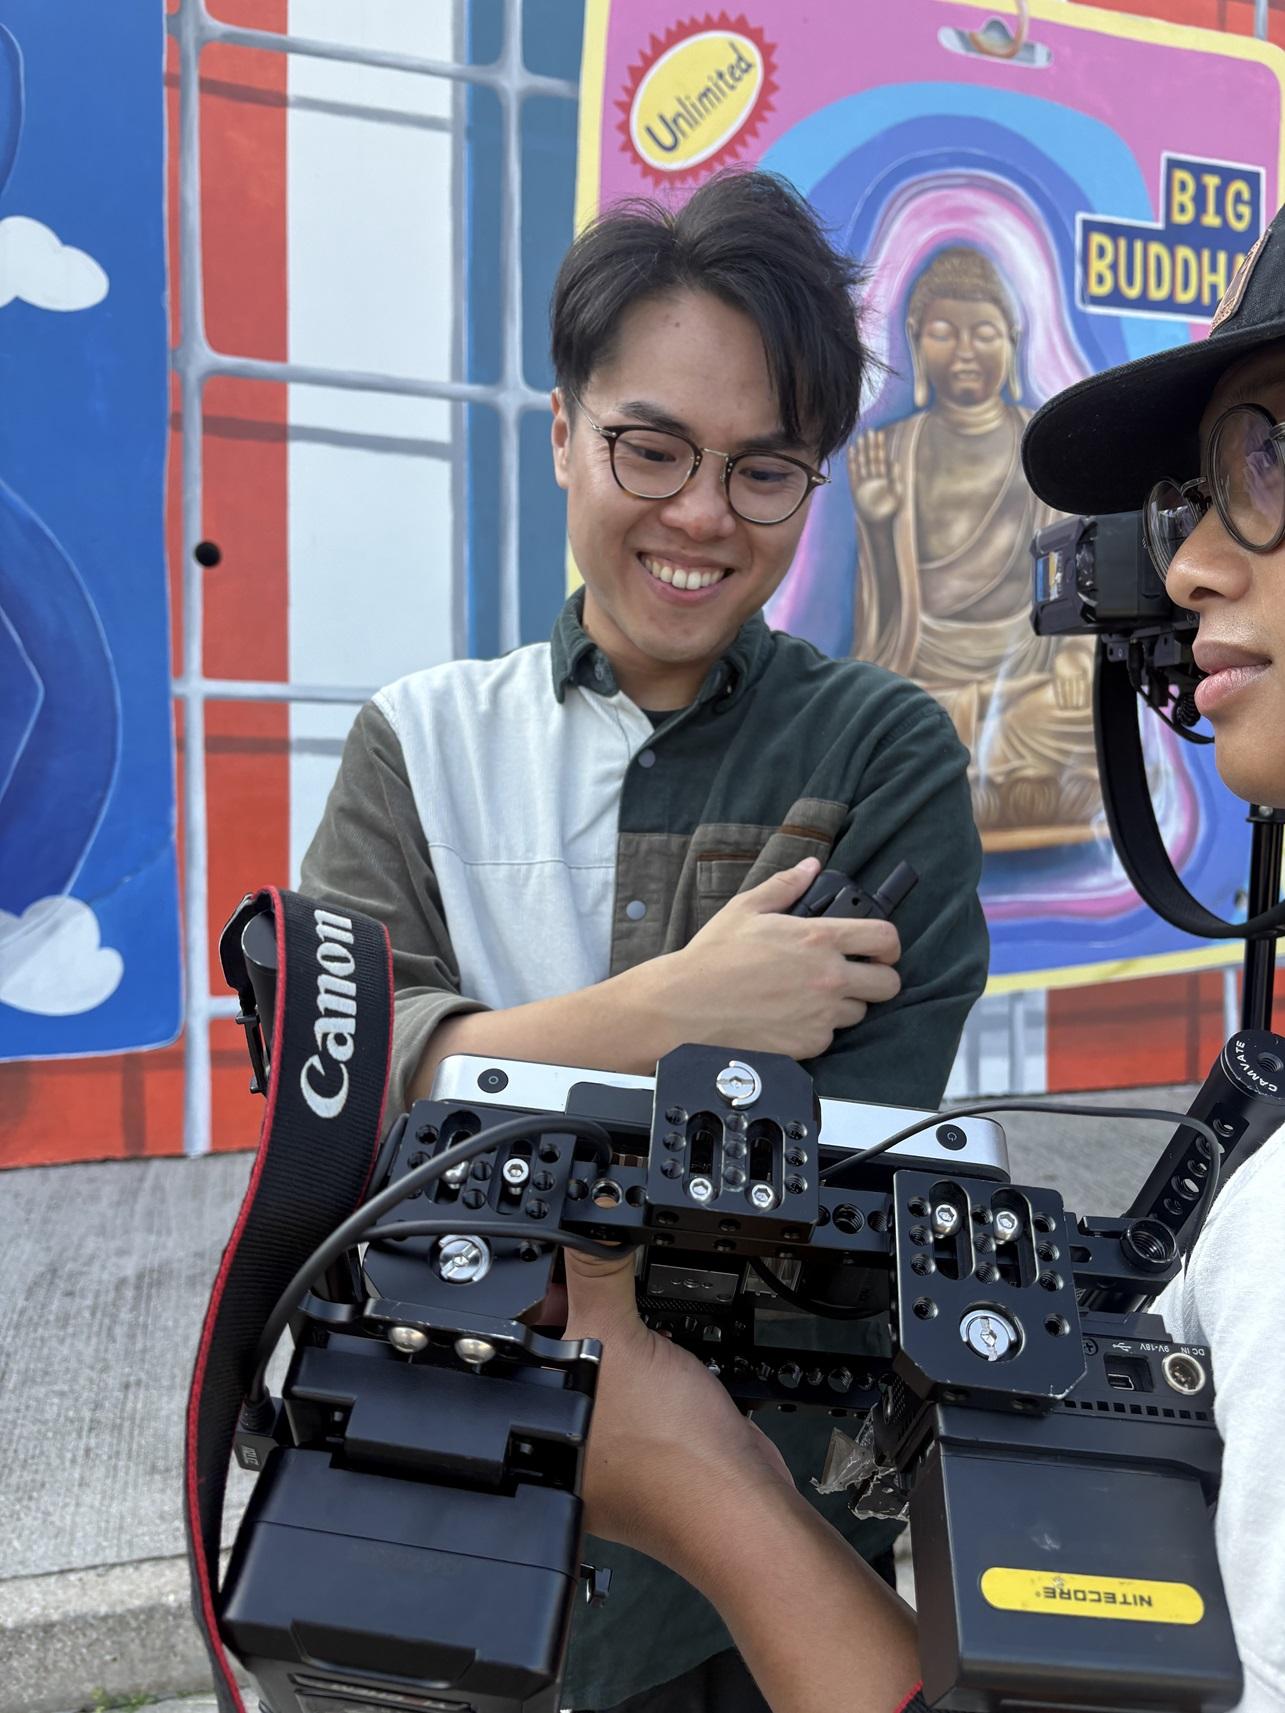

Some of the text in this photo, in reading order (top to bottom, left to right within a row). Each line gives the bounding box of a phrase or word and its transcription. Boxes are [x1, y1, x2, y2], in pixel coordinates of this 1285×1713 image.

[645, 41, 753, 152] Unlimited
[1171, 168, 1252, 232] BIG
[1088, 231, 1246, 306] BUDDH
[300, 909, 357, 1119] Canon
[1236, 1040, 1278, 1092] CAMVATE
[1180, 1346, 1191, 1354] IN
[1192, 1348, 1205, 1356] DC
